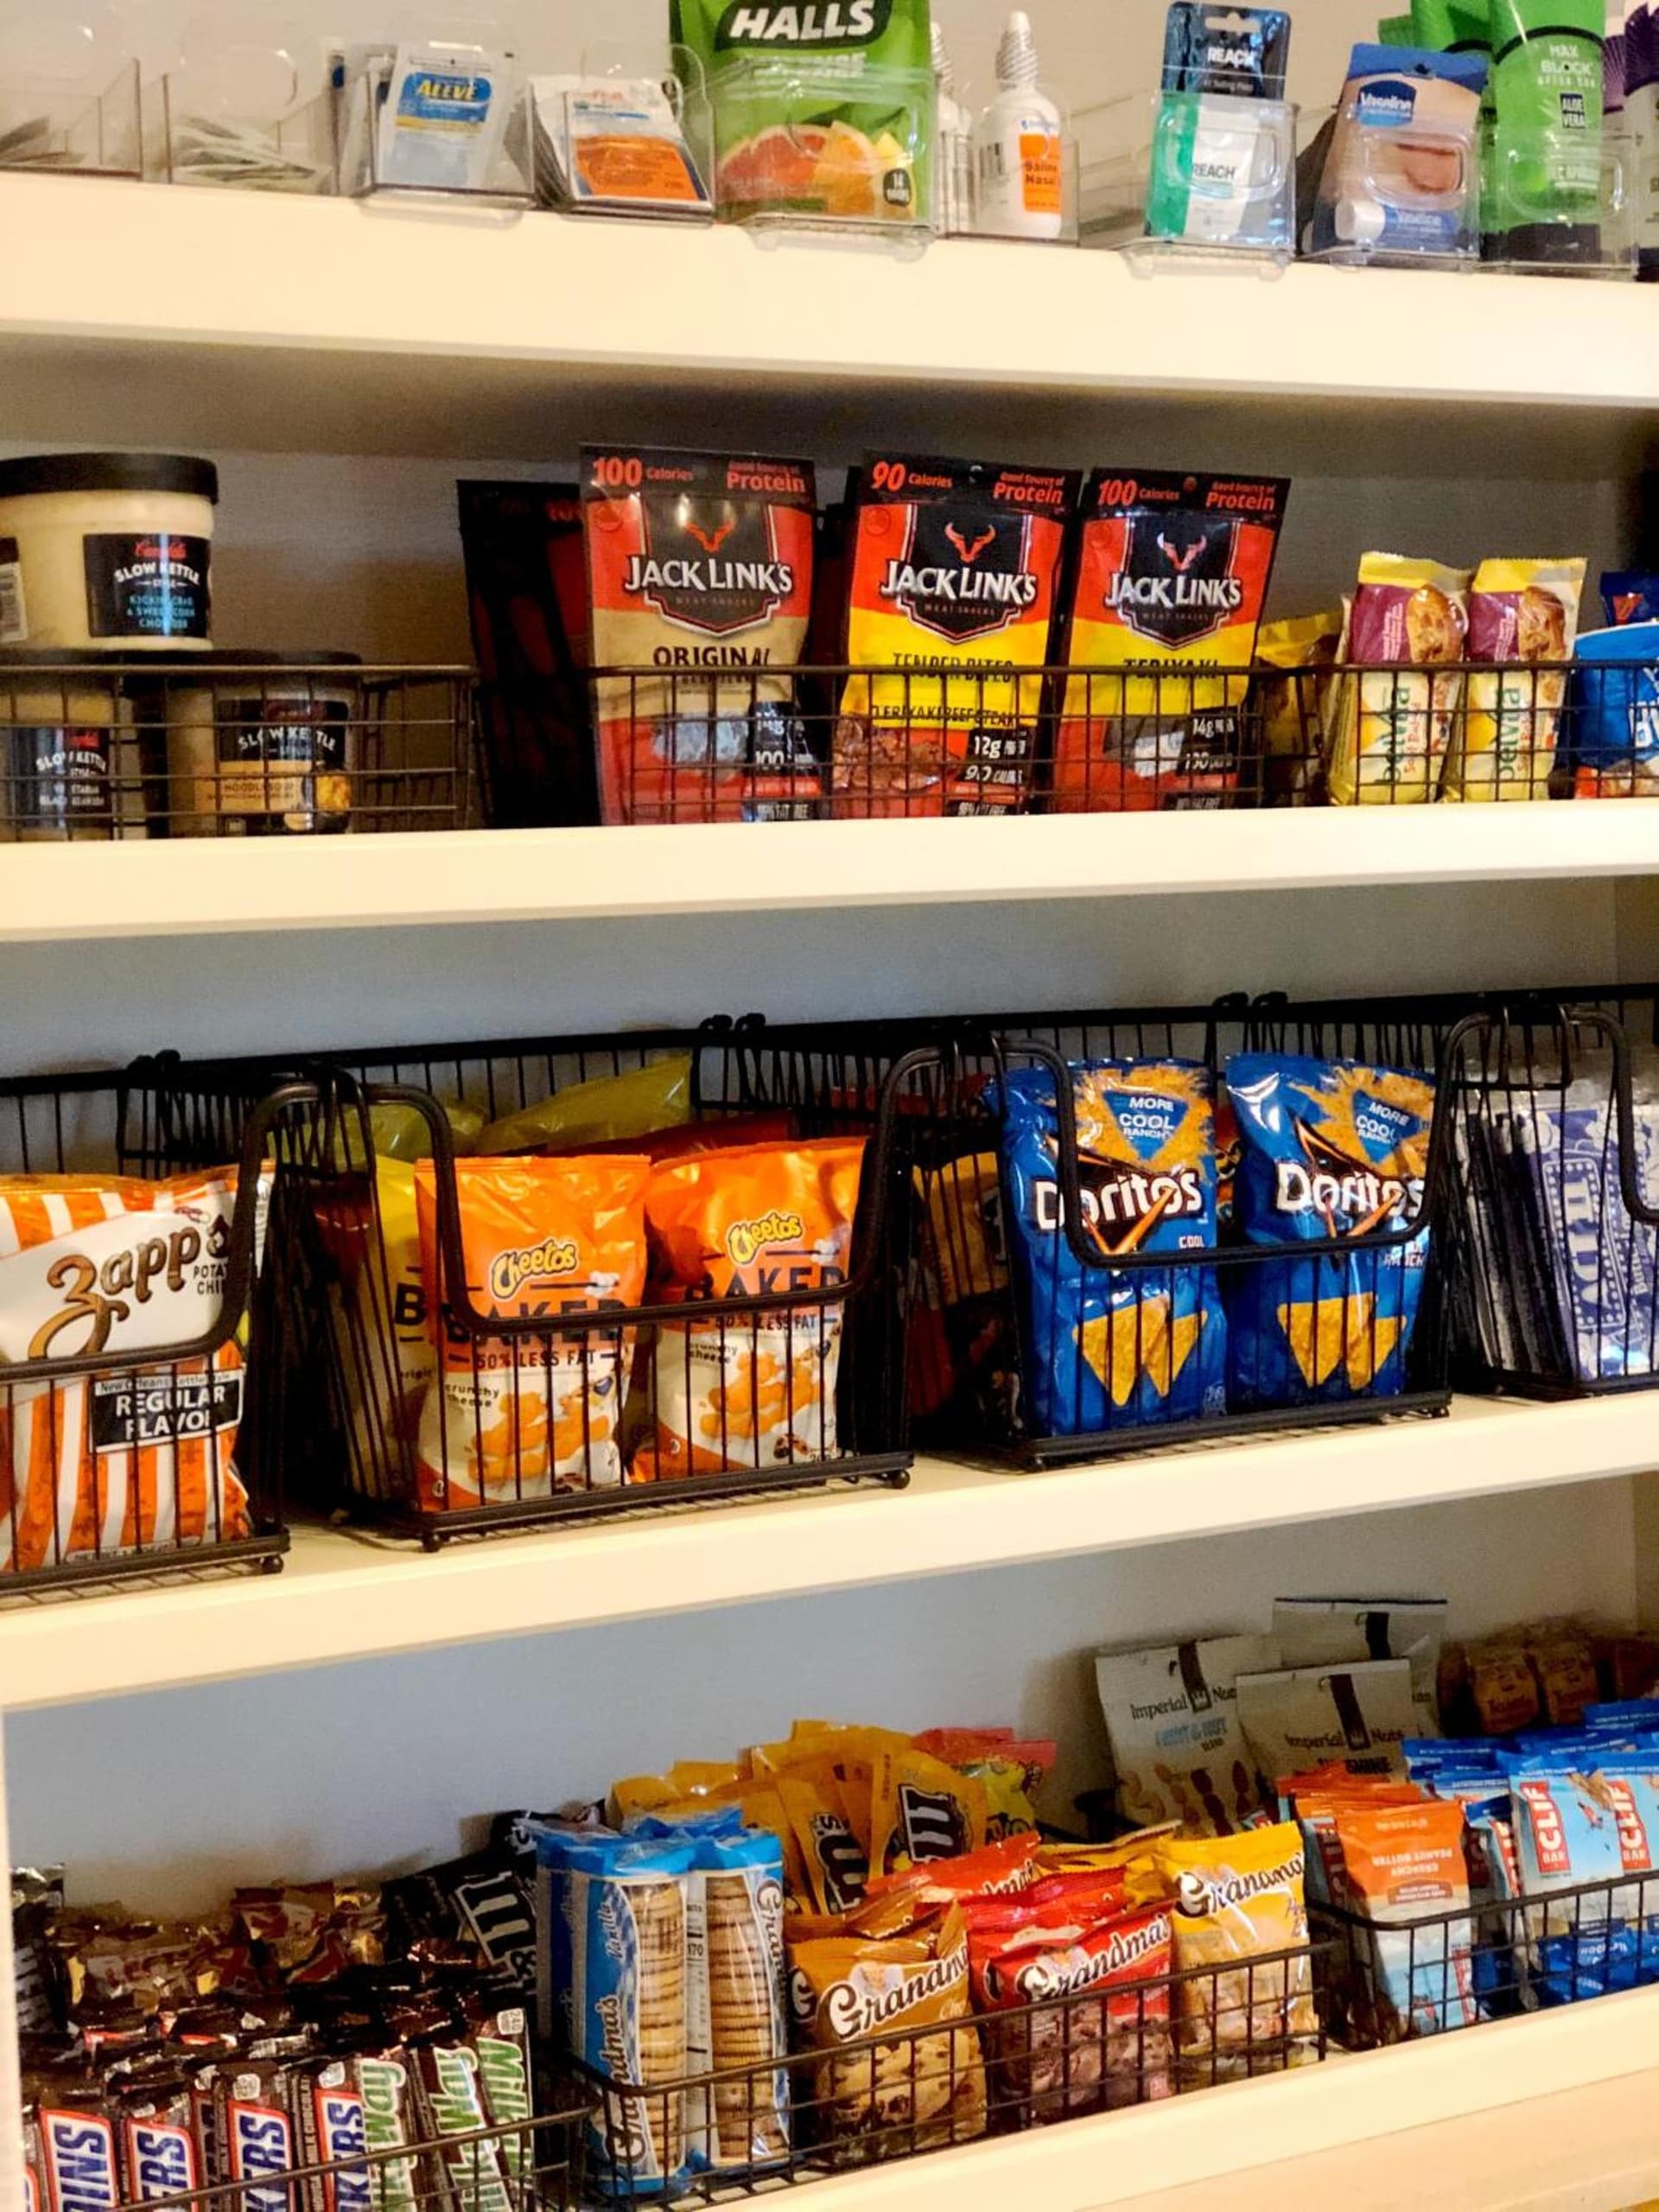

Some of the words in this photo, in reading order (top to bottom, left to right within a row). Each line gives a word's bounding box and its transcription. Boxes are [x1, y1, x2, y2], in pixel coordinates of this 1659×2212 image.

[729, 0, 874, 41] HALLS
[1207, 47, 1257, 67] REACH
[1540, 60, 1592, 76] BLOCK
[1192, 162, 1236, 178] REACH
[593, 457, 643, 487] 100
[726, 470, 806, 493] Protein
[871, 461, 906, 492] 90
[908, 473, 953, 489] Calories
[994, 481, 1064, 504] Protein
[1097, 478, 1138, 507] 100
[1139, 488, 1180, 501] Calories
[1205, 491, 1275, 511] Protein
[113, 562, 156, 583] SLOW
[159, 563, 200, 585] KETTLE
[624, 556, 707, 591] JACK
[708, 558, 793, 594] LINK'S
[880, 561, 957, 600] JACK
[959, 567, 1037, 605] LINK'S
[1104, 571, 1174, 607] JACK
[1175, 575, 1243, 608] LINK'S
[287, 727, 337, 752] KETLE
[1128, 1096, 1174, 1112] MORE
[1368, 1101, 1411, 1127] MORE
[1119, 1111, 1174, 1129] COOL
[1356, 1115, 1396, 1142] COOL
[1037, 1167, 1203, 1230] Doritos
[1276, 1160, 1425, 1218] Doritos
[730, 1212, 803, 1264] Cheetos
[1179, 1235, 1205, 1249] COOL
[192, 1263, 227, 1281] POTA
[491, 1240, 579, 1300] Cheetos
[196, 1278, 223, 1295] CHI
[518, 1351, 560, 1368] LESS
[567, 1349, 596, 1365] FAT
[115, 1384, 226, 1418] REGULAR
[1129, 1692, 1189, 1720] Imperial
[1522, 1786, 1562, 1851] CLIF
[1608, 1786, 1643, 1853] CLIF
[1541, 1851, 1567, 1864] BAR
[1622, 1848, 1648, 1862] BAR
[598, 1900, 626, 1960] Vanilla
[687, 1942, 704, 1956] 170
